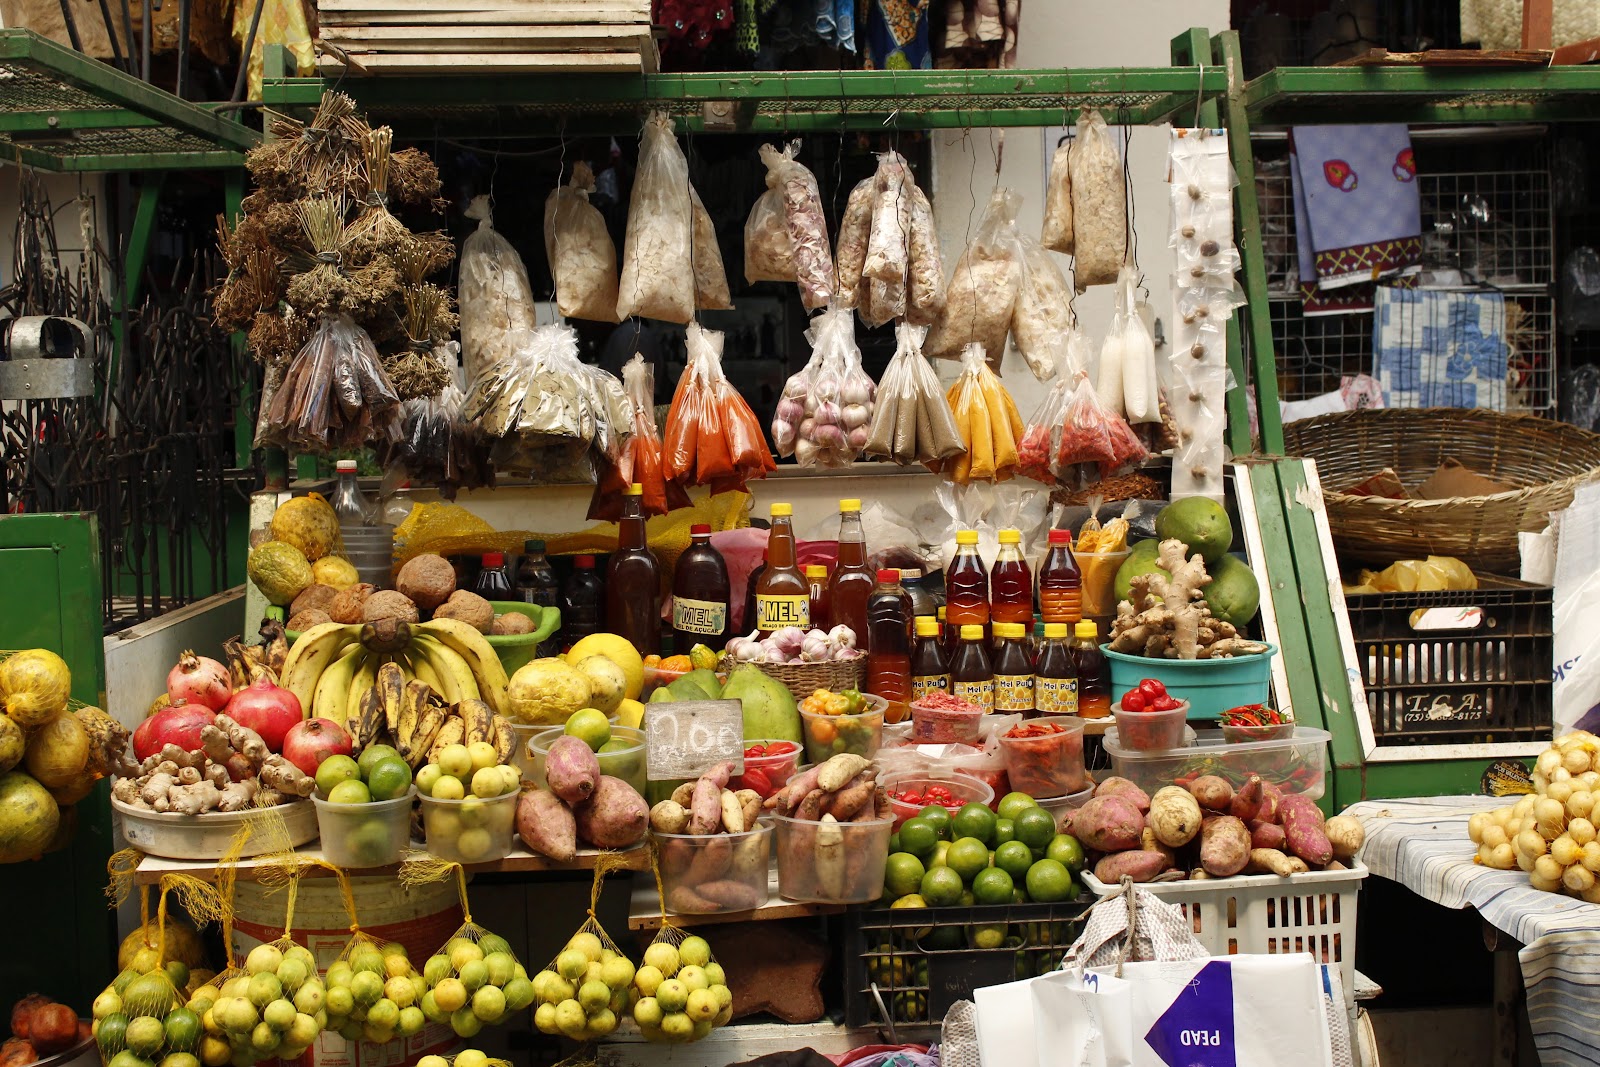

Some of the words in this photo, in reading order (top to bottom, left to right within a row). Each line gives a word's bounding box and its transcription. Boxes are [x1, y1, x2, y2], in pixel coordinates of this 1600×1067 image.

[682, 606, 713, 627] MEL
[766, 600, 799, 621] MEL
[967, 685, 981, 694] Mel
[1001, 680, 1013, 688] Mel
[1043, 682, 1057, 690] Mel
[1180, 1030, 1221, 1047] PEAD
